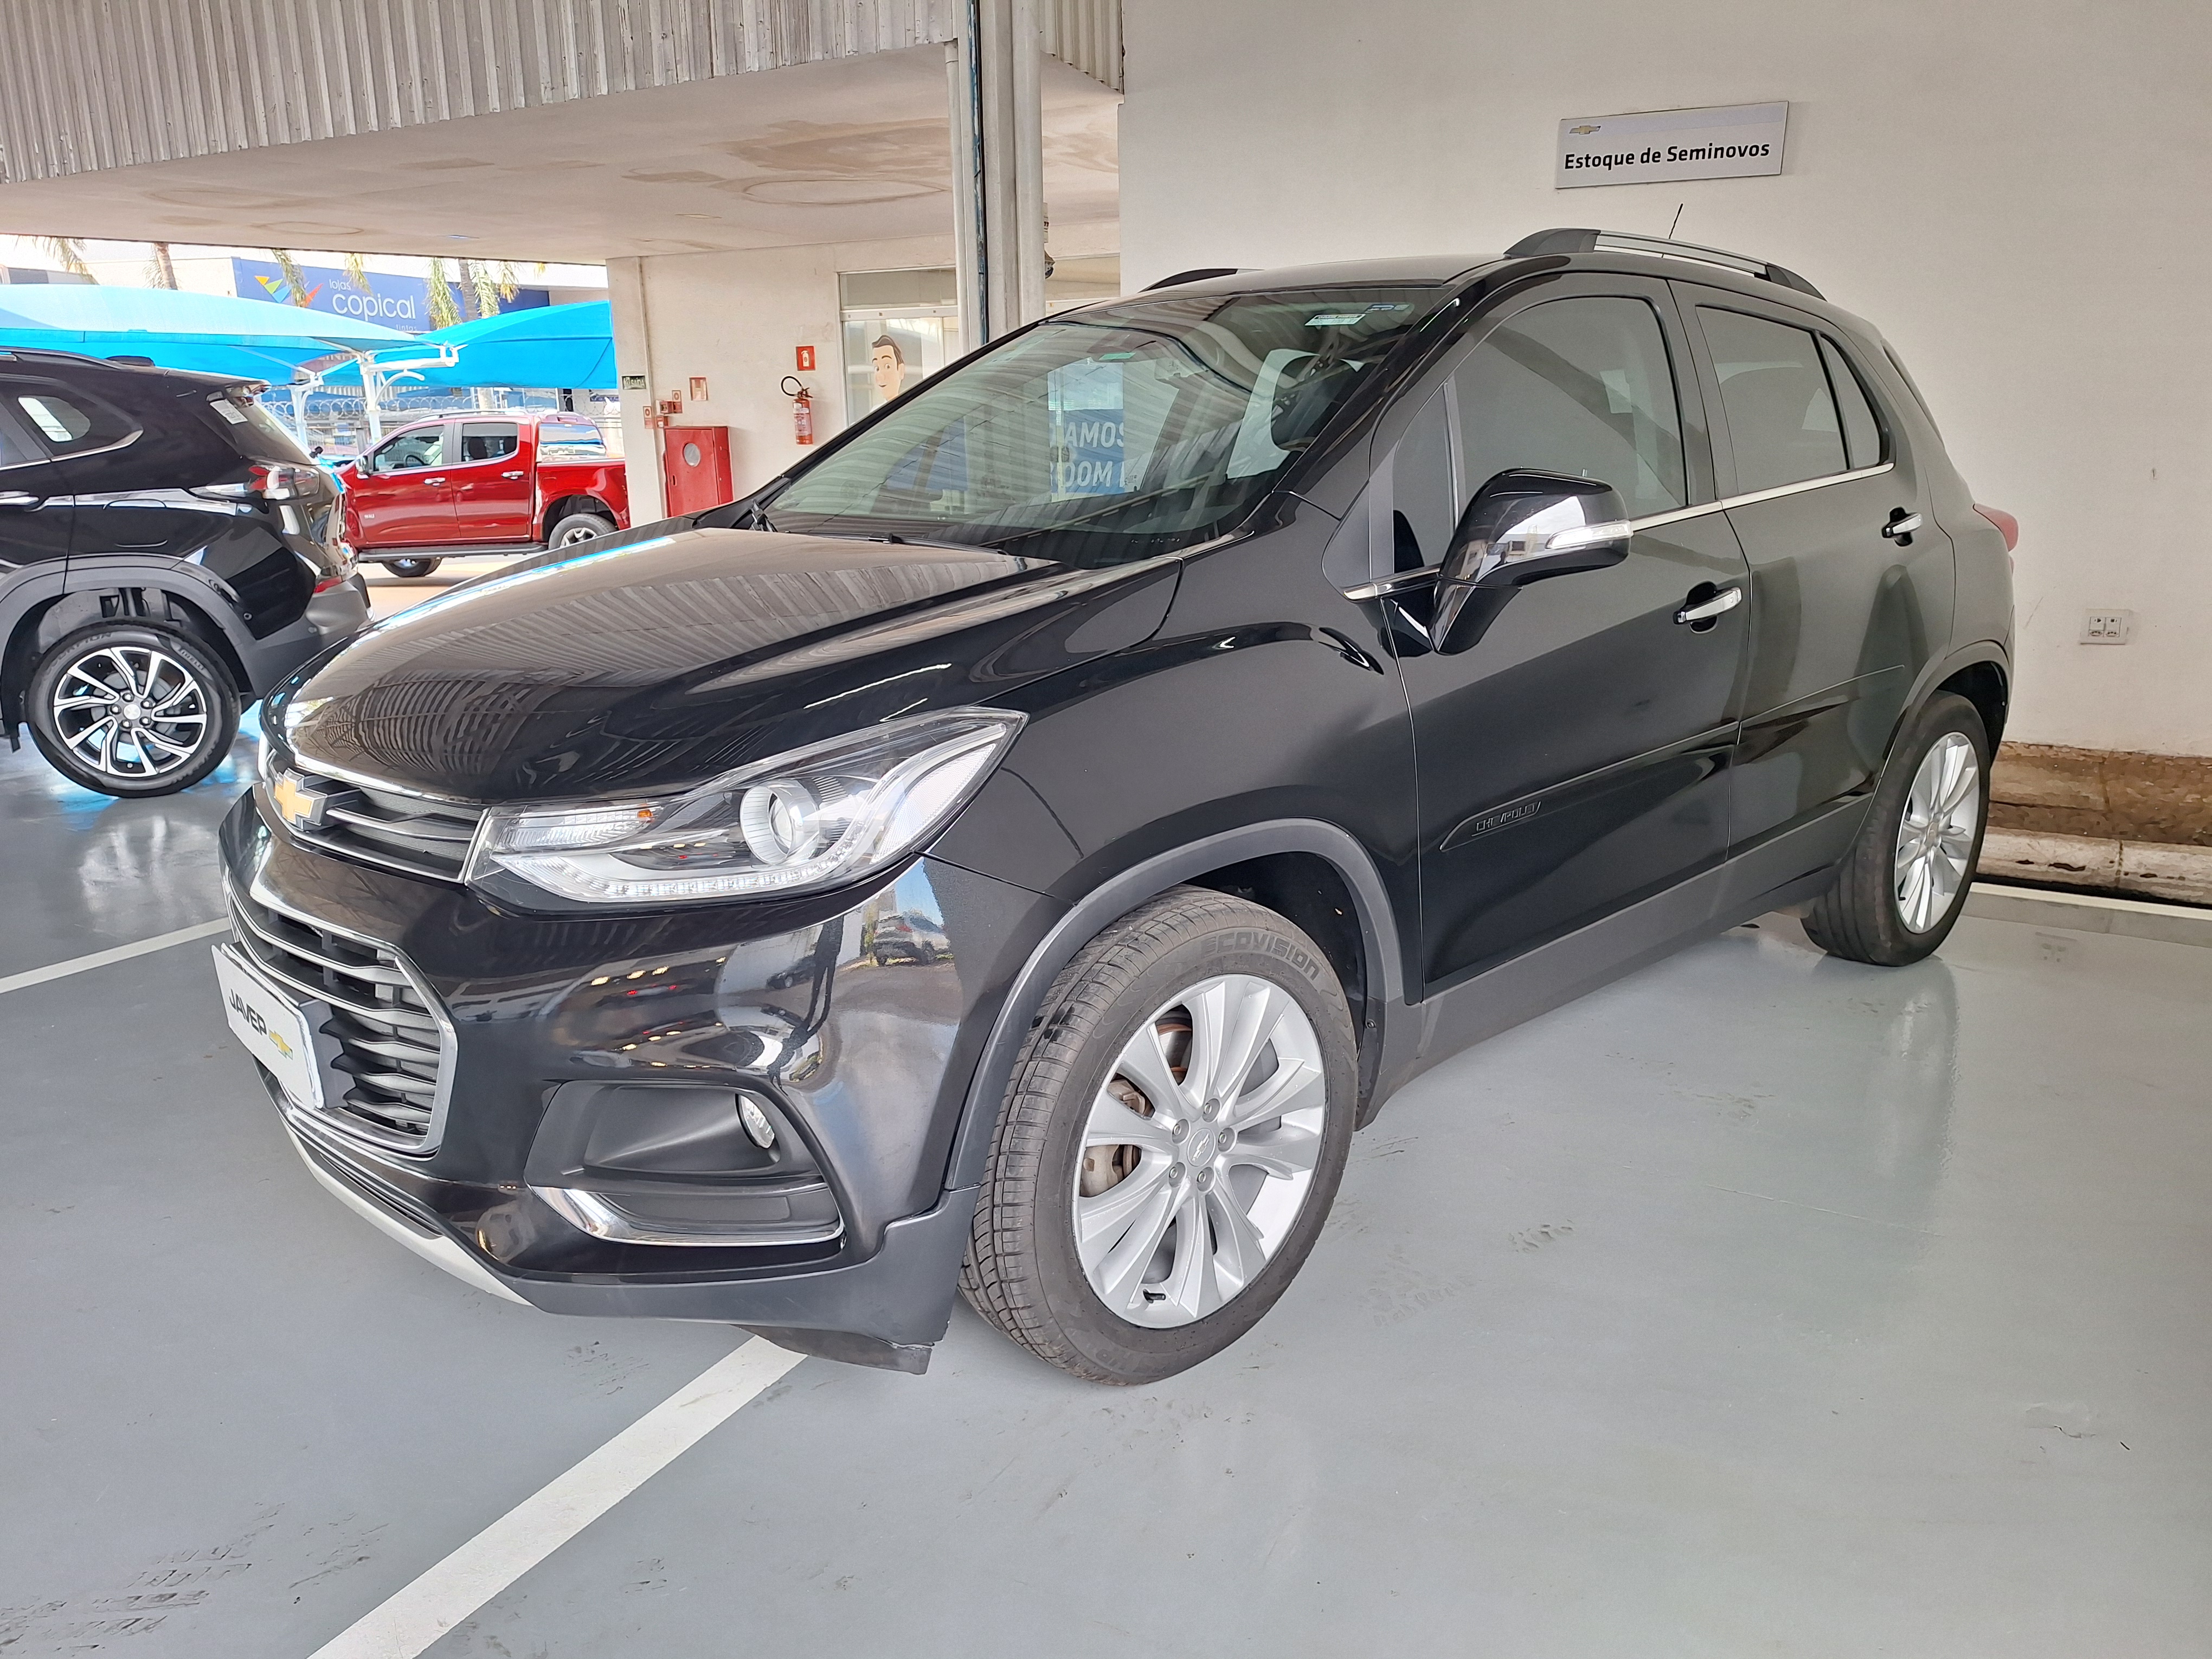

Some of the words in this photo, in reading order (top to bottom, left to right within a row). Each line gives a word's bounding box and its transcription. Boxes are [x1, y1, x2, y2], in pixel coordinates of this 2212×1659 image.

[1565, 152, 1635, 170] Estoque
[1640, 147, 1661, 164] de
[1666, 143, 1770, 162] Seminovos
[329, 279, 352, 291] lojas
[332, 293, 416, 321] copical
